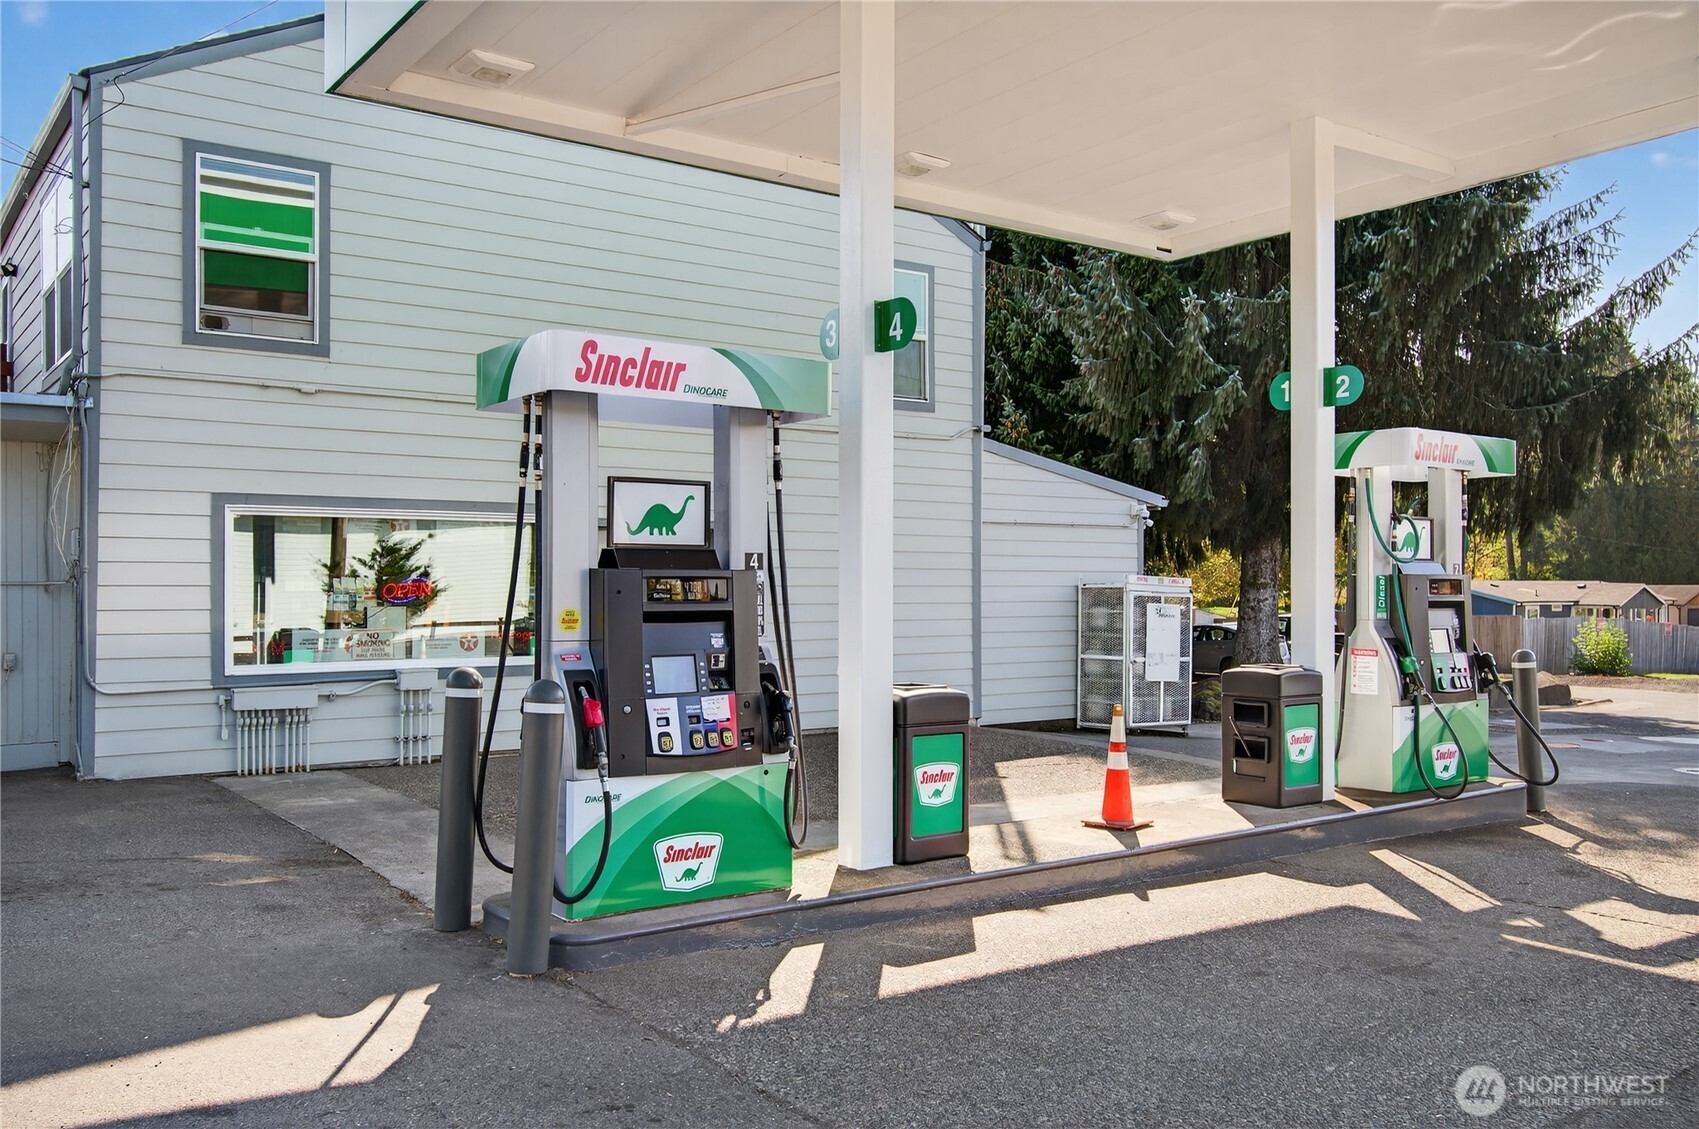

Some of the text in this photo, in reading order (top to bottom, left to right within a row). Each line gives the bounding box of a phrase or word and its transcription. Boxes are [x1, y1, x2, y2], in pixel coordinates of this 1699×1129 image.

[825, 320, 837, 347] 3
[889, 312, 903, 341] 4
[575, 339, 687, 392] Sinclair
[683, 384, 729, 398] DINOCARE
[1280, 381, 1290, 402] 1
[1335, 375, 1350, 398] 2
[1414, 433, 1460, 464] Sinclair
[749, 553, 759, 569] 4
[382, 582, 433, 599] OPEN
[1378, 575, 1386, 608] Diesel
[366, 632, 380, 640] NO
[920, 769, 955, 785] Sinclair
[663, 841, 717, 864] Sinclair
